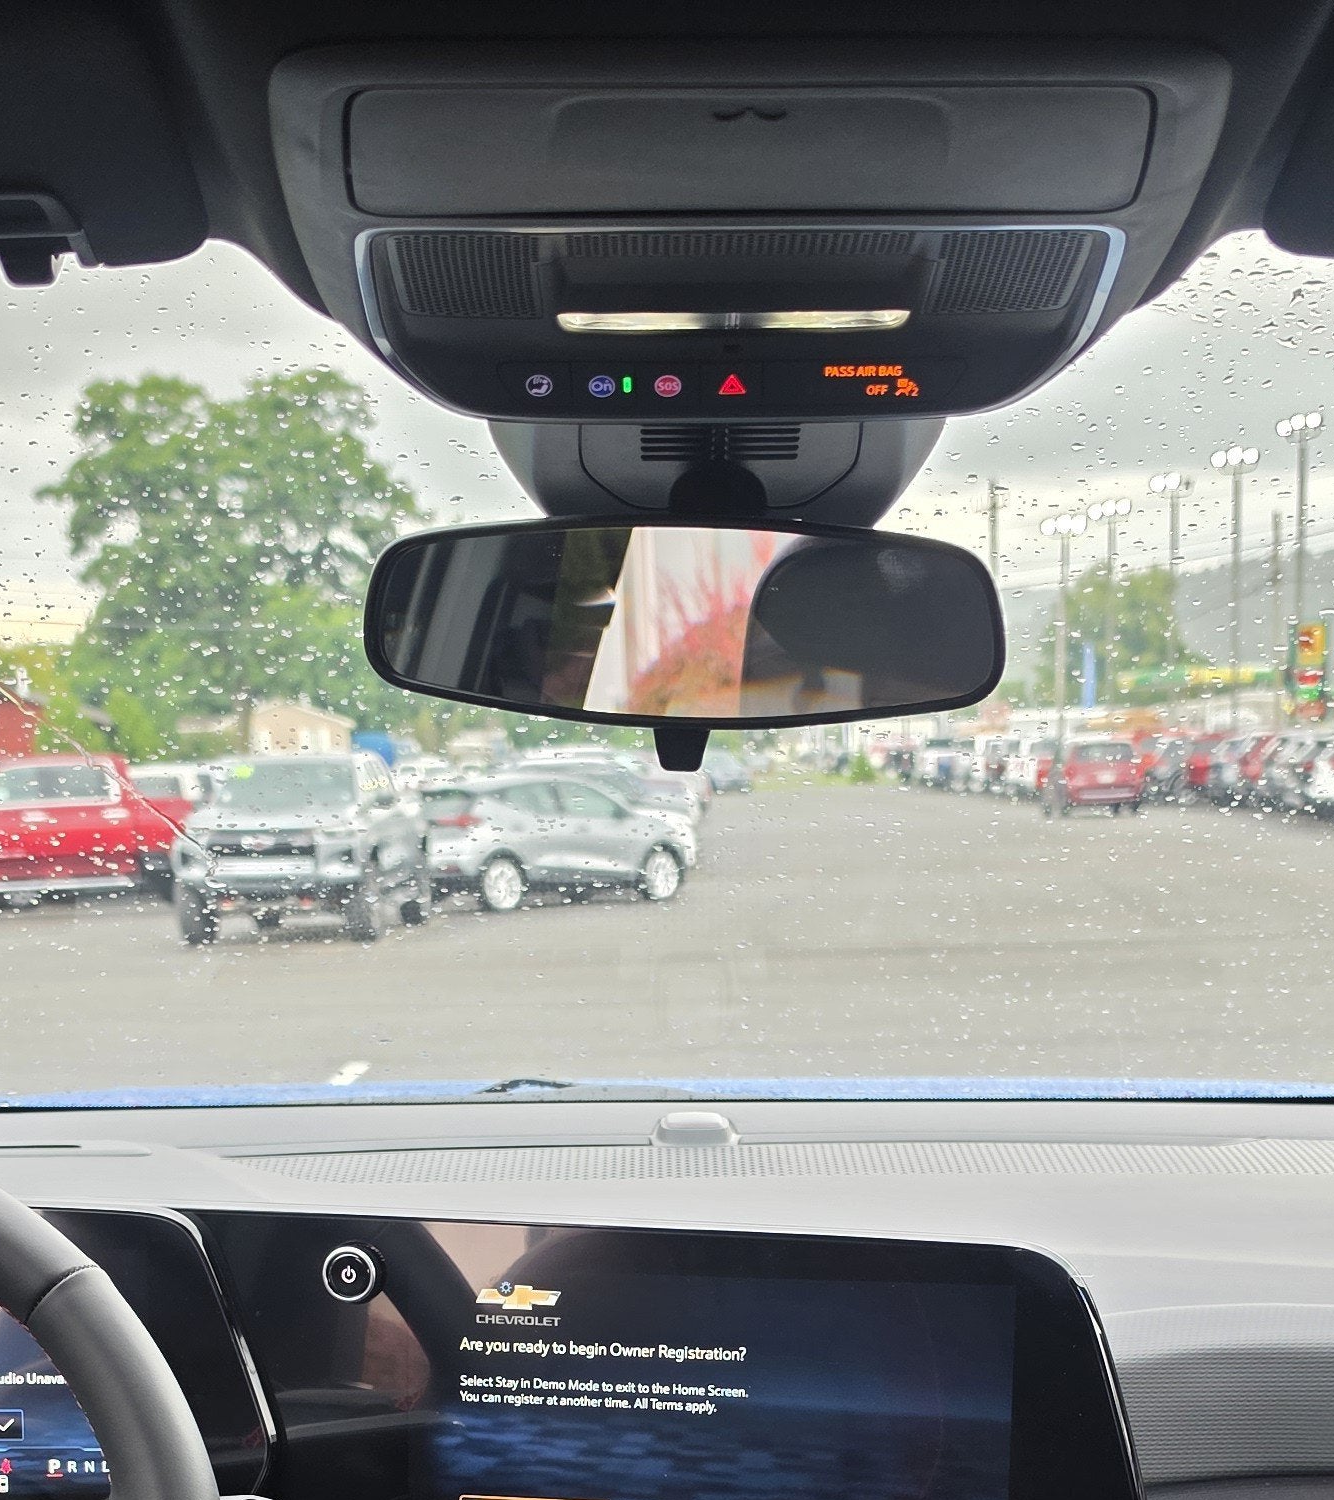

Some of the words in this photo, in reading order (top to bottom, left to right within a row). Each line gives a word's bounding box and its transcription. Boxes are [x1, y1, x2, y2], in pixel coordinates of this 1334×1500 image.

[824, 366, 854, 377] PASS
[856, 366, 877, 376] AIR
[879, 365, 902, 377] BAG
[657, 381, 678, 391] SOS
[866, 385, 888, 396] OFF
[475, 1314, 562, 1327] CHEVROLET
[459, 1337, 484, 1352] Are
[485, 1340, 510, 1356] you
[513, 1340, 550, 1358] ready
[552, 1342, 567, 1355] to
[569, 1341, 606, 1359] begin
[609, 1343, 655, 1358] Owner
[658, 1345, 747, 1363] Registration?
[459, 1375, 494, 1388] Select
[495, 1376, 518, 1391] Stay
[520, 1377, 531, 1389] in
[533, 1378, 566, 1391] Demo
[568, 1379, 599, 1393] Mode
[601, 1381, 613, 1393] to
[615, 1381, 636, 1394] exit
[637, 1382, 649, 1395] to
[651, 1383, 670, 1395] the
[672, 1384, 705, 1397] Home
[707, 1385, 749, 1398] Screen.
[459, 1390, 479, 1403] You
[481, 1392, 501, 1404] can
[503, 1392, 544, 1407] register
[546, 1394, 558, 1406] at
[560, 1395, 602, 1408] another
[604, 1396, 632, 1410] time.
[633, 1397, 648, 1410] All
[650, 1398, 683, 1412] Terms
[684, 1400, 718, 1416] apply.
[48, 1459, 61, 1474] P
[67, 1461, 77, 1473] R
[85, 1461, 95, 1473] N
